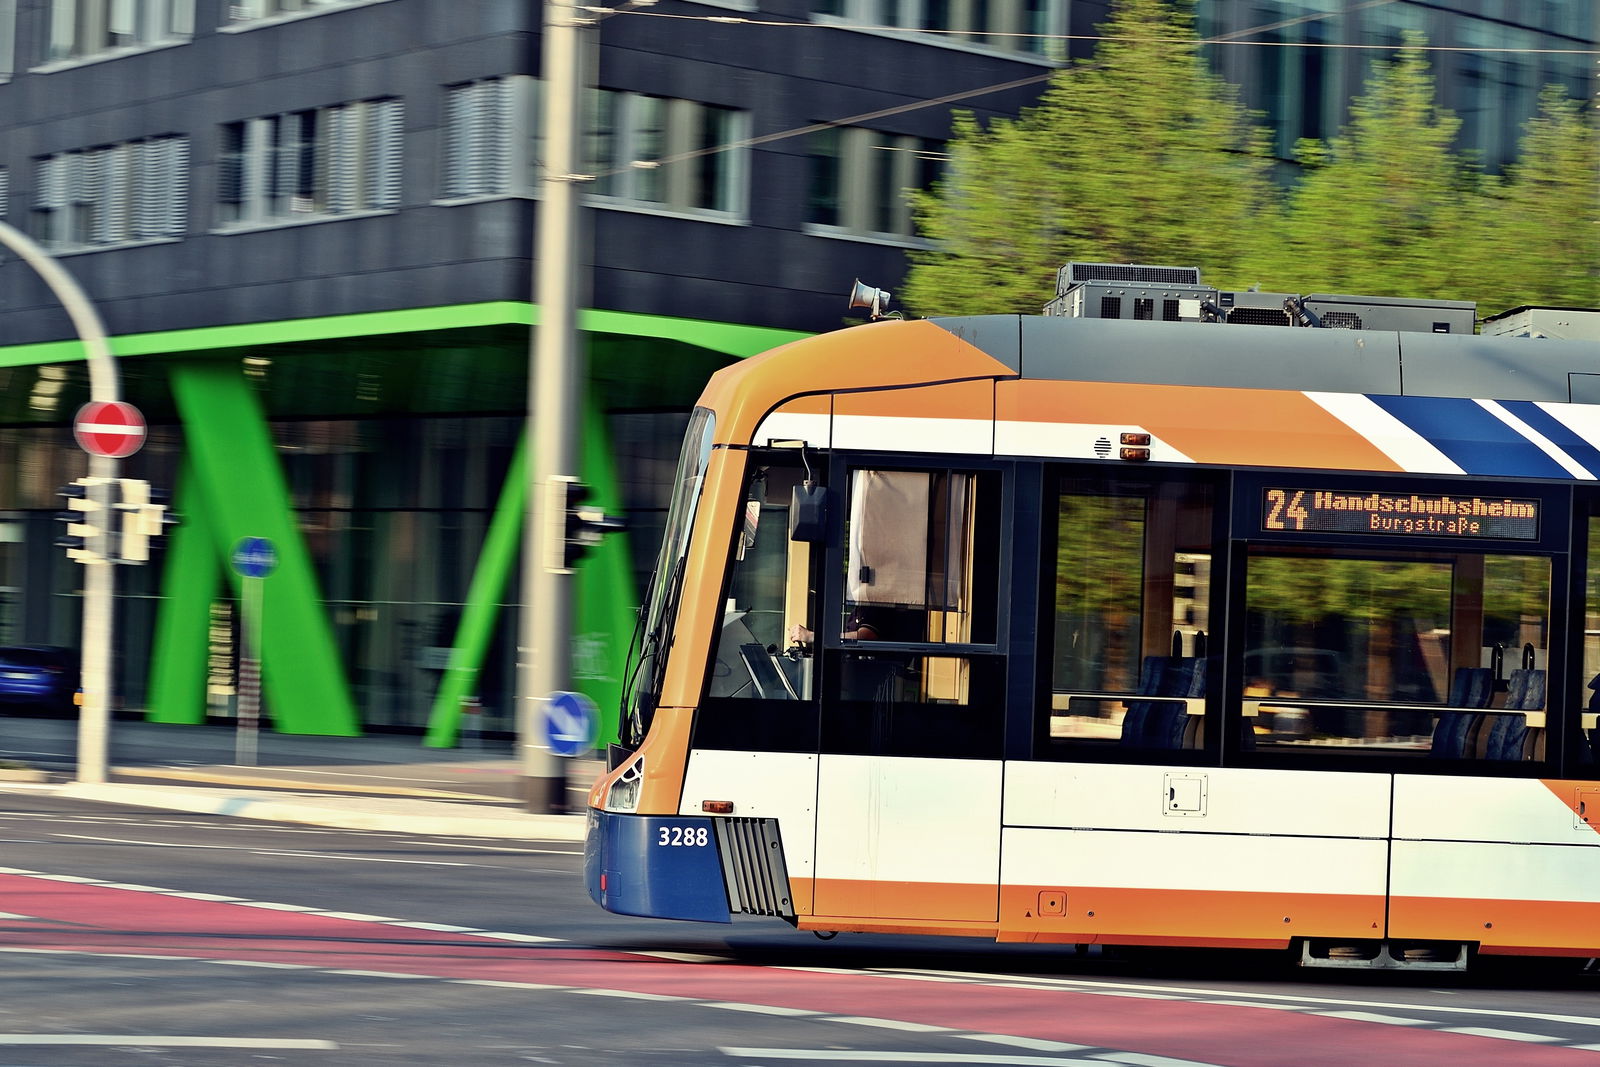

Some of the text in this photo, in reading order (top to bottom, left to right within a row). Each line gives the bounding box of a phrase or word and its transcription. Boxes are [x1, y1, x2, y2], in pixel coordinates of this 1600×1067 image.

[1266, 489, 1308, 530] 24
[1314, 491, 1535, 518] Handschuhsheim
[1370, 513, 1480, 534] Burgstraße
[658, 826, 708, 847] 3288
